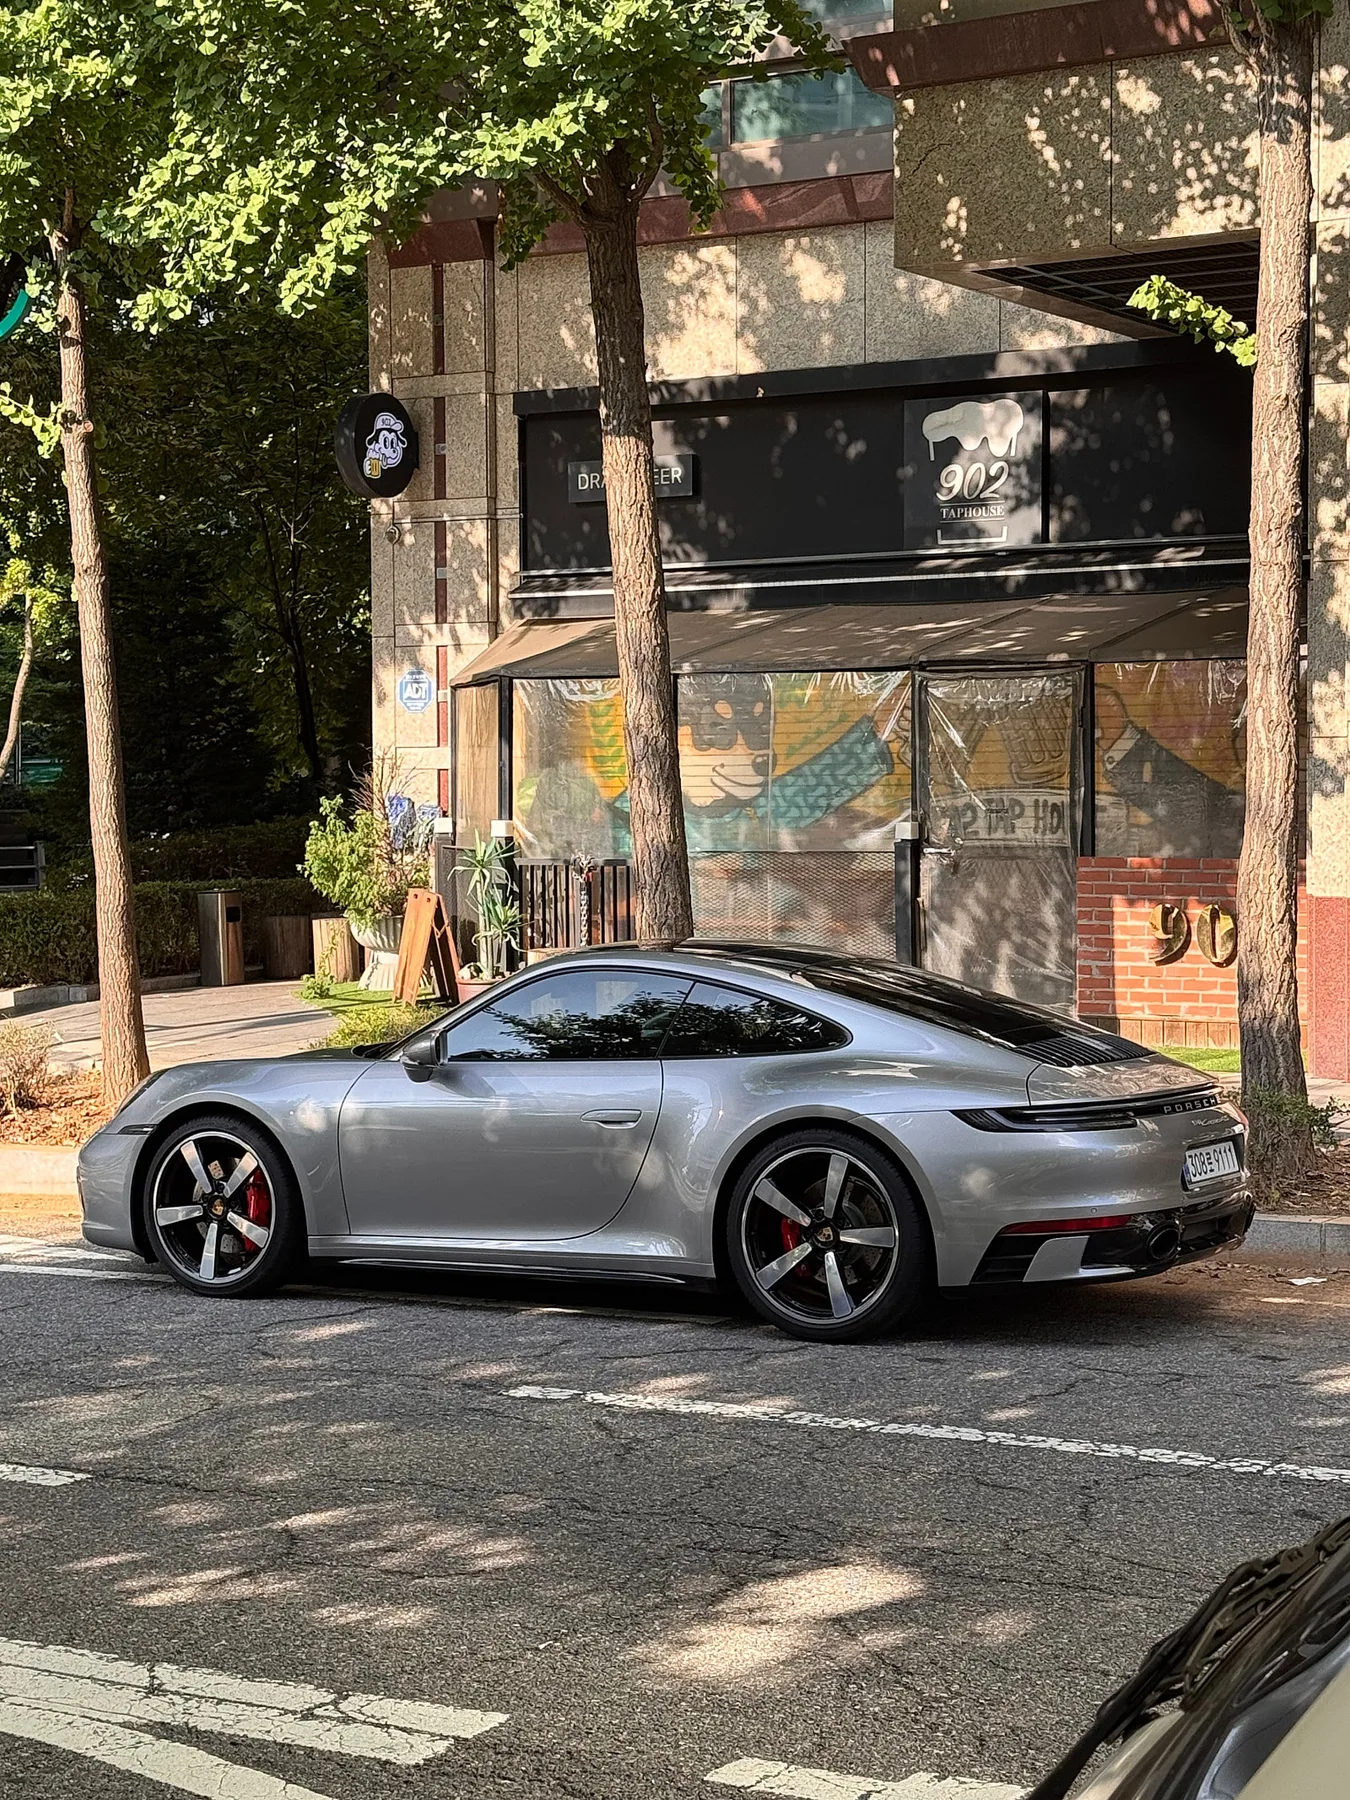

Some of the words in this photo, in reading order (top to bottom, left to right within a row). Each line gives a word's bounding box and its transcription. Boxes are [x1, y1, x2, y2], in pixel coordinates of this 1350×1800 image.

[936, 461, 1009, 501] 902
[940, 505, 1005, 519] TAPHOUSE
[404, 682, 428, 699] ADT
[1163, 1093, 1221, 1114] PORSCHE
